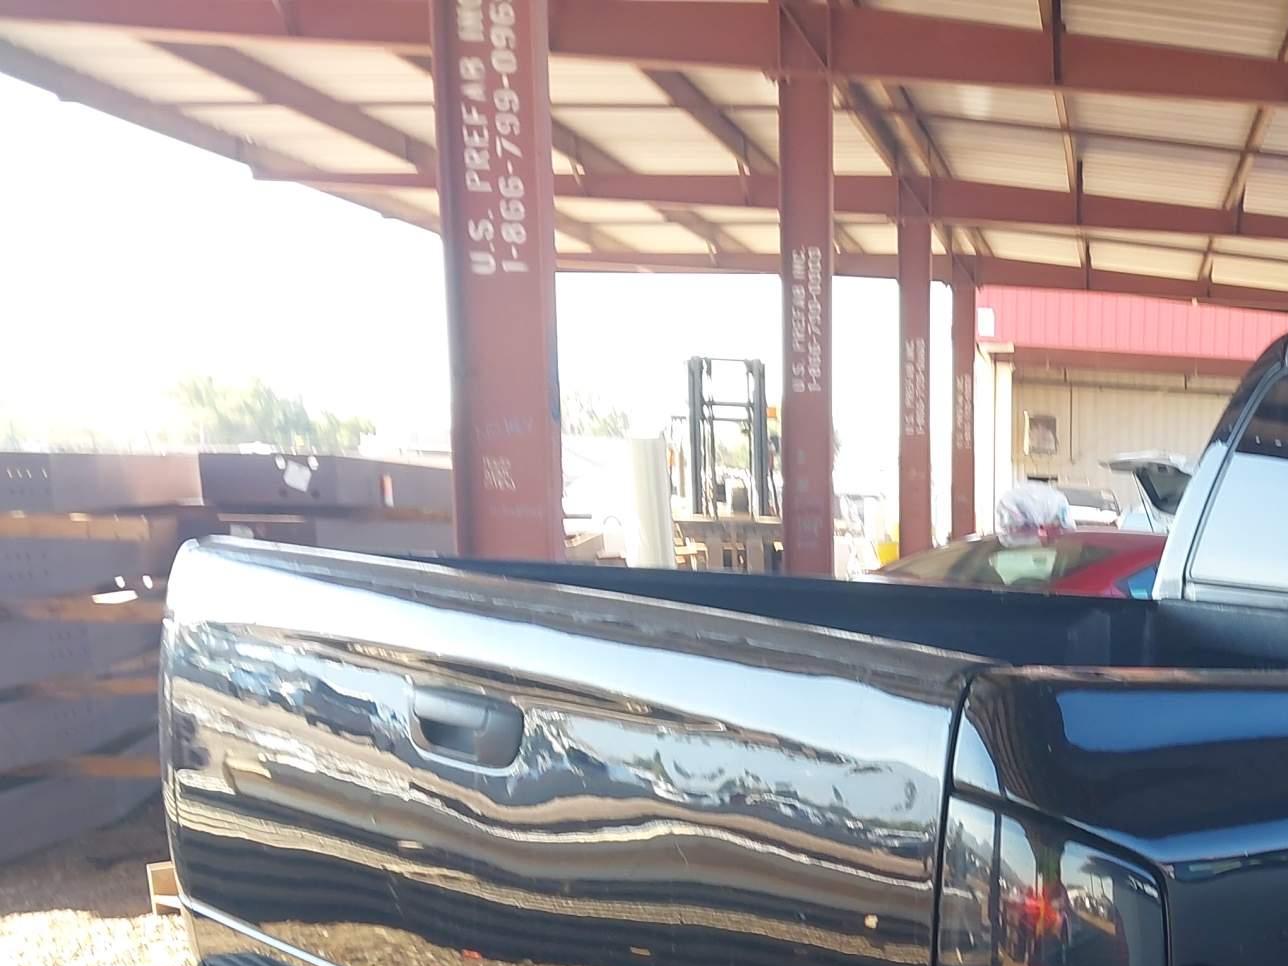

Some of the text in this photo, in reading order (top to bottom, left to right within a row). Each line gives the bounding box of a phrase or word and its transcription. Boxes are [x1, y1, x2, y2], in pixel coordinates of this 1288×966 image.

[459, 56, 493, 192] PREFAB
[489, 0, 530, 272] 1-866-799-096
[468, 208, 497, 275] U.S.
